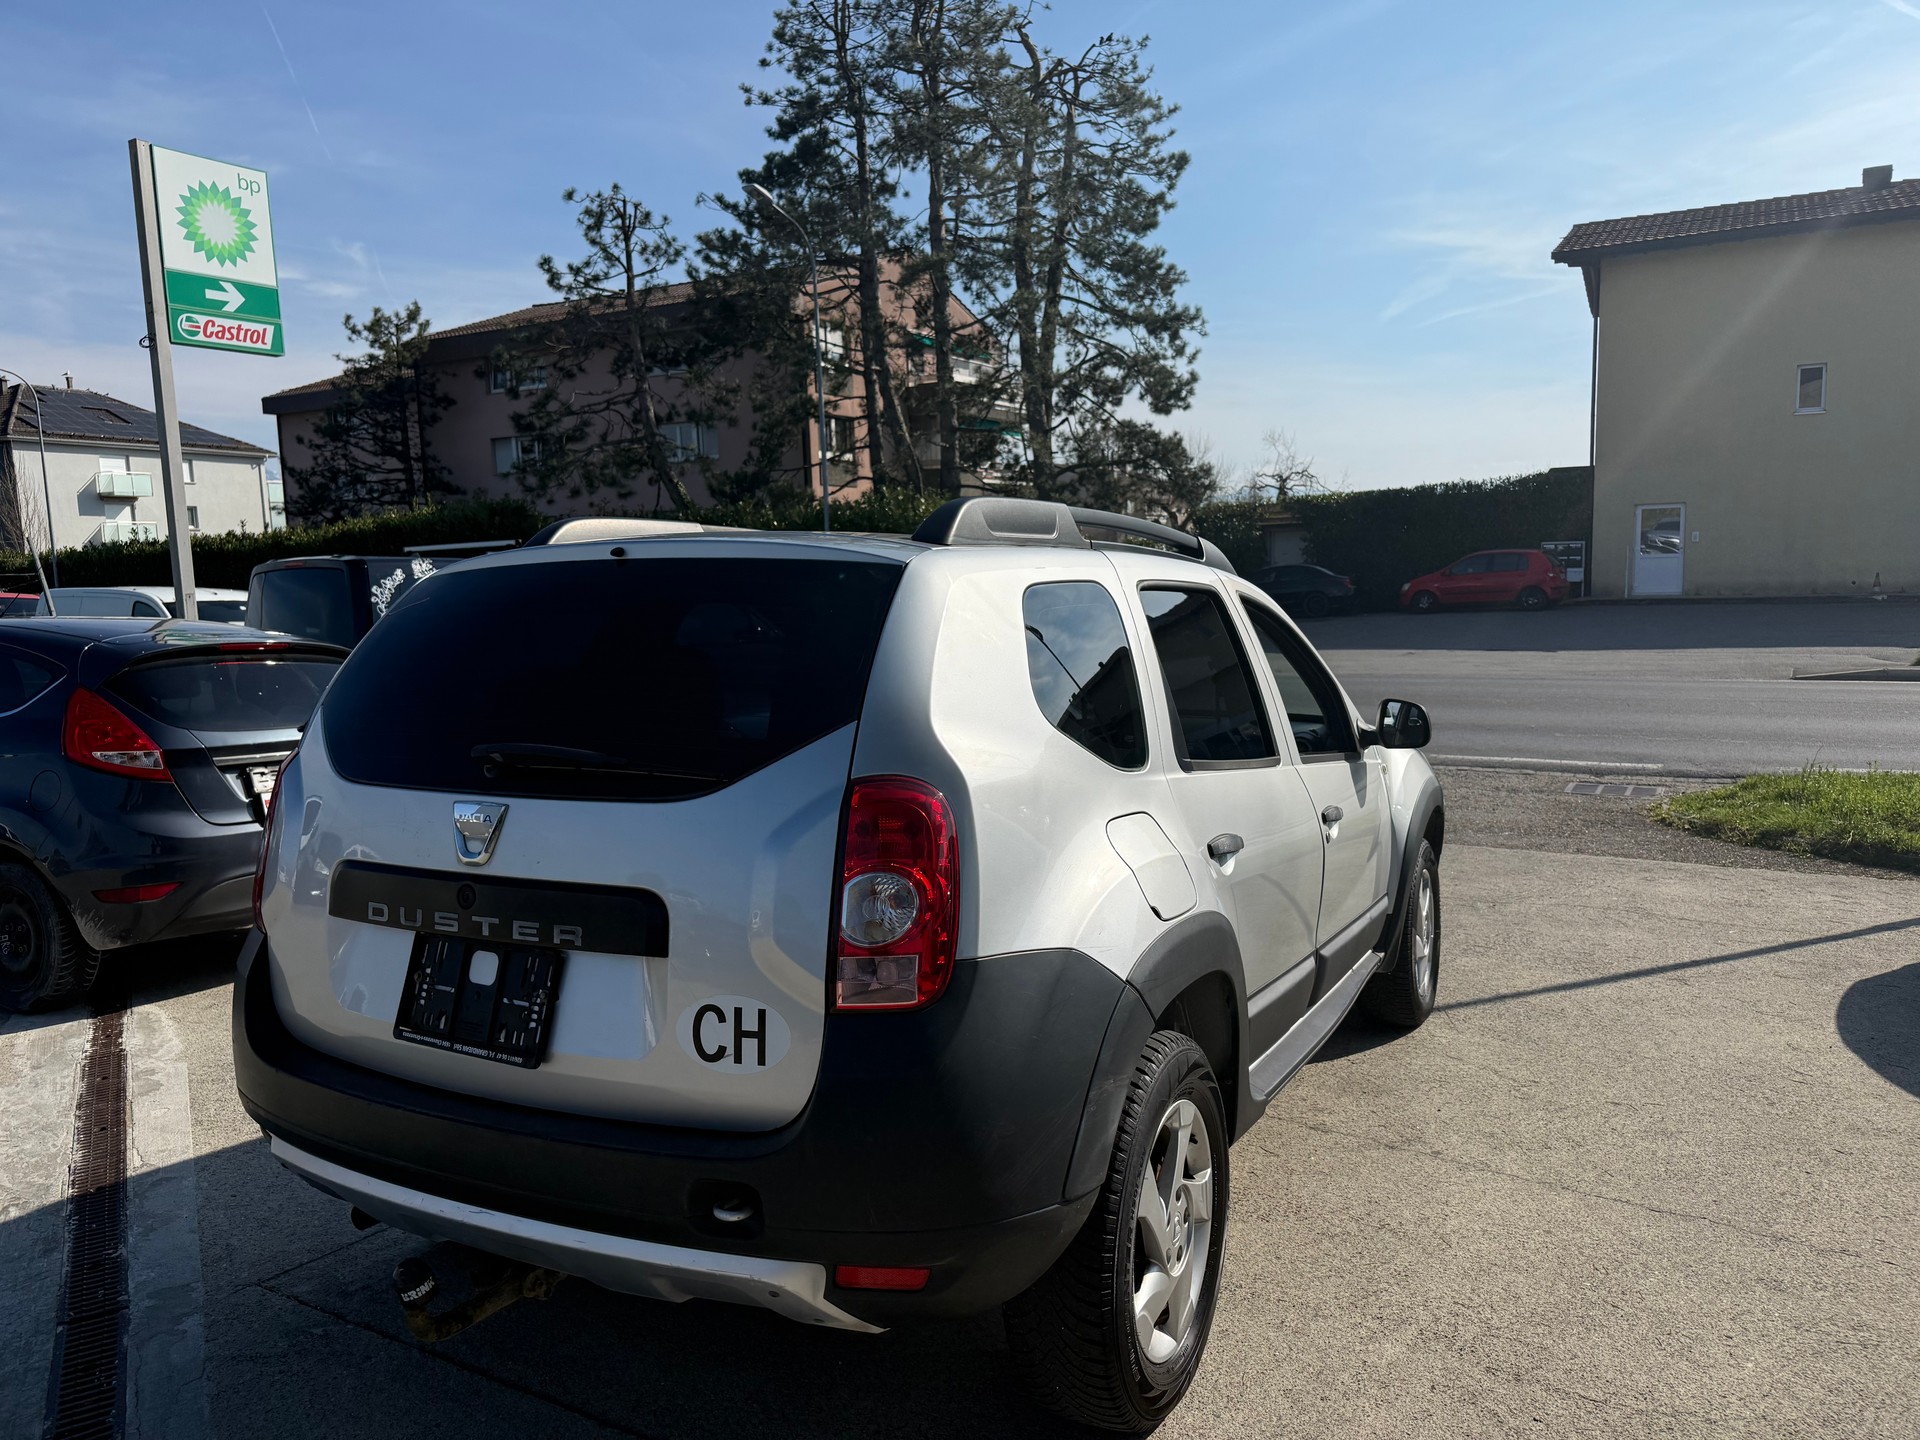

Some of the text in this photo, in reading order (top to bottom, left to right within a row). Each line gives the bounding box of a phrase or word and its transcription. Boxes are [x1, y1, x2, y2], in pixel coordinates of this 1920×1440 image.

[237, 173, 261, 196] bp
[202, 318, 268, 346] Castrol
[457, 812, 492, 823] DACIA
[367, 901, 582, 947] DUSTER
[692, 1003, 767, 1067] CH
